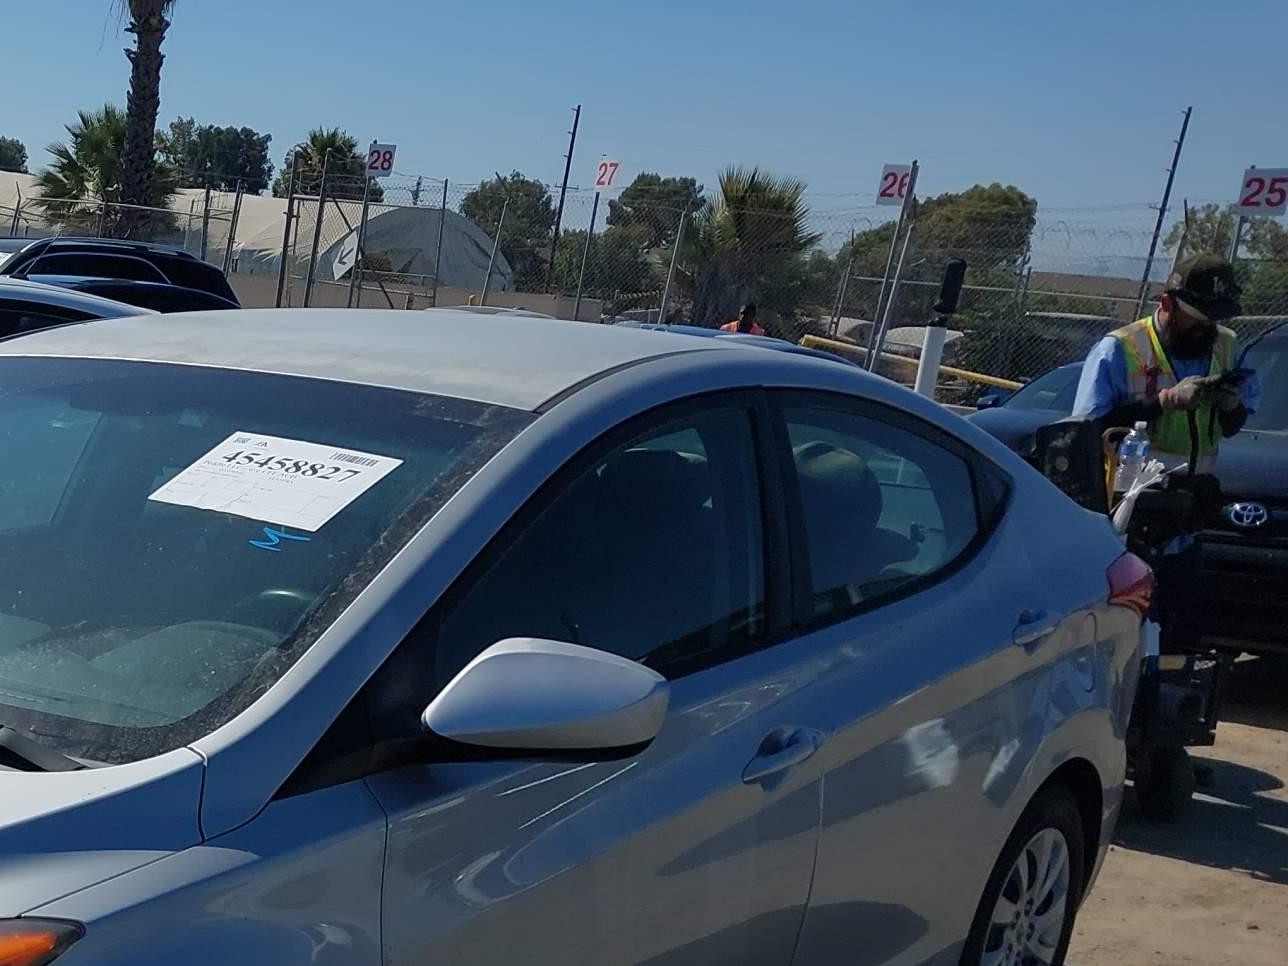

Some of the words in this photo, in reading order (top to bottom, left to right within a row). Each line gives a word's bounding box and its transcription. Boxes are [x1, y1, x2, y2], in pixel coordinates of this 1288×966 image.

[368, 150, 393, 171] 28
[596, 162, 619, 186] 27
[1240, 177, 1288, 208] 25
[222, 450, 361, 483] 45458827
